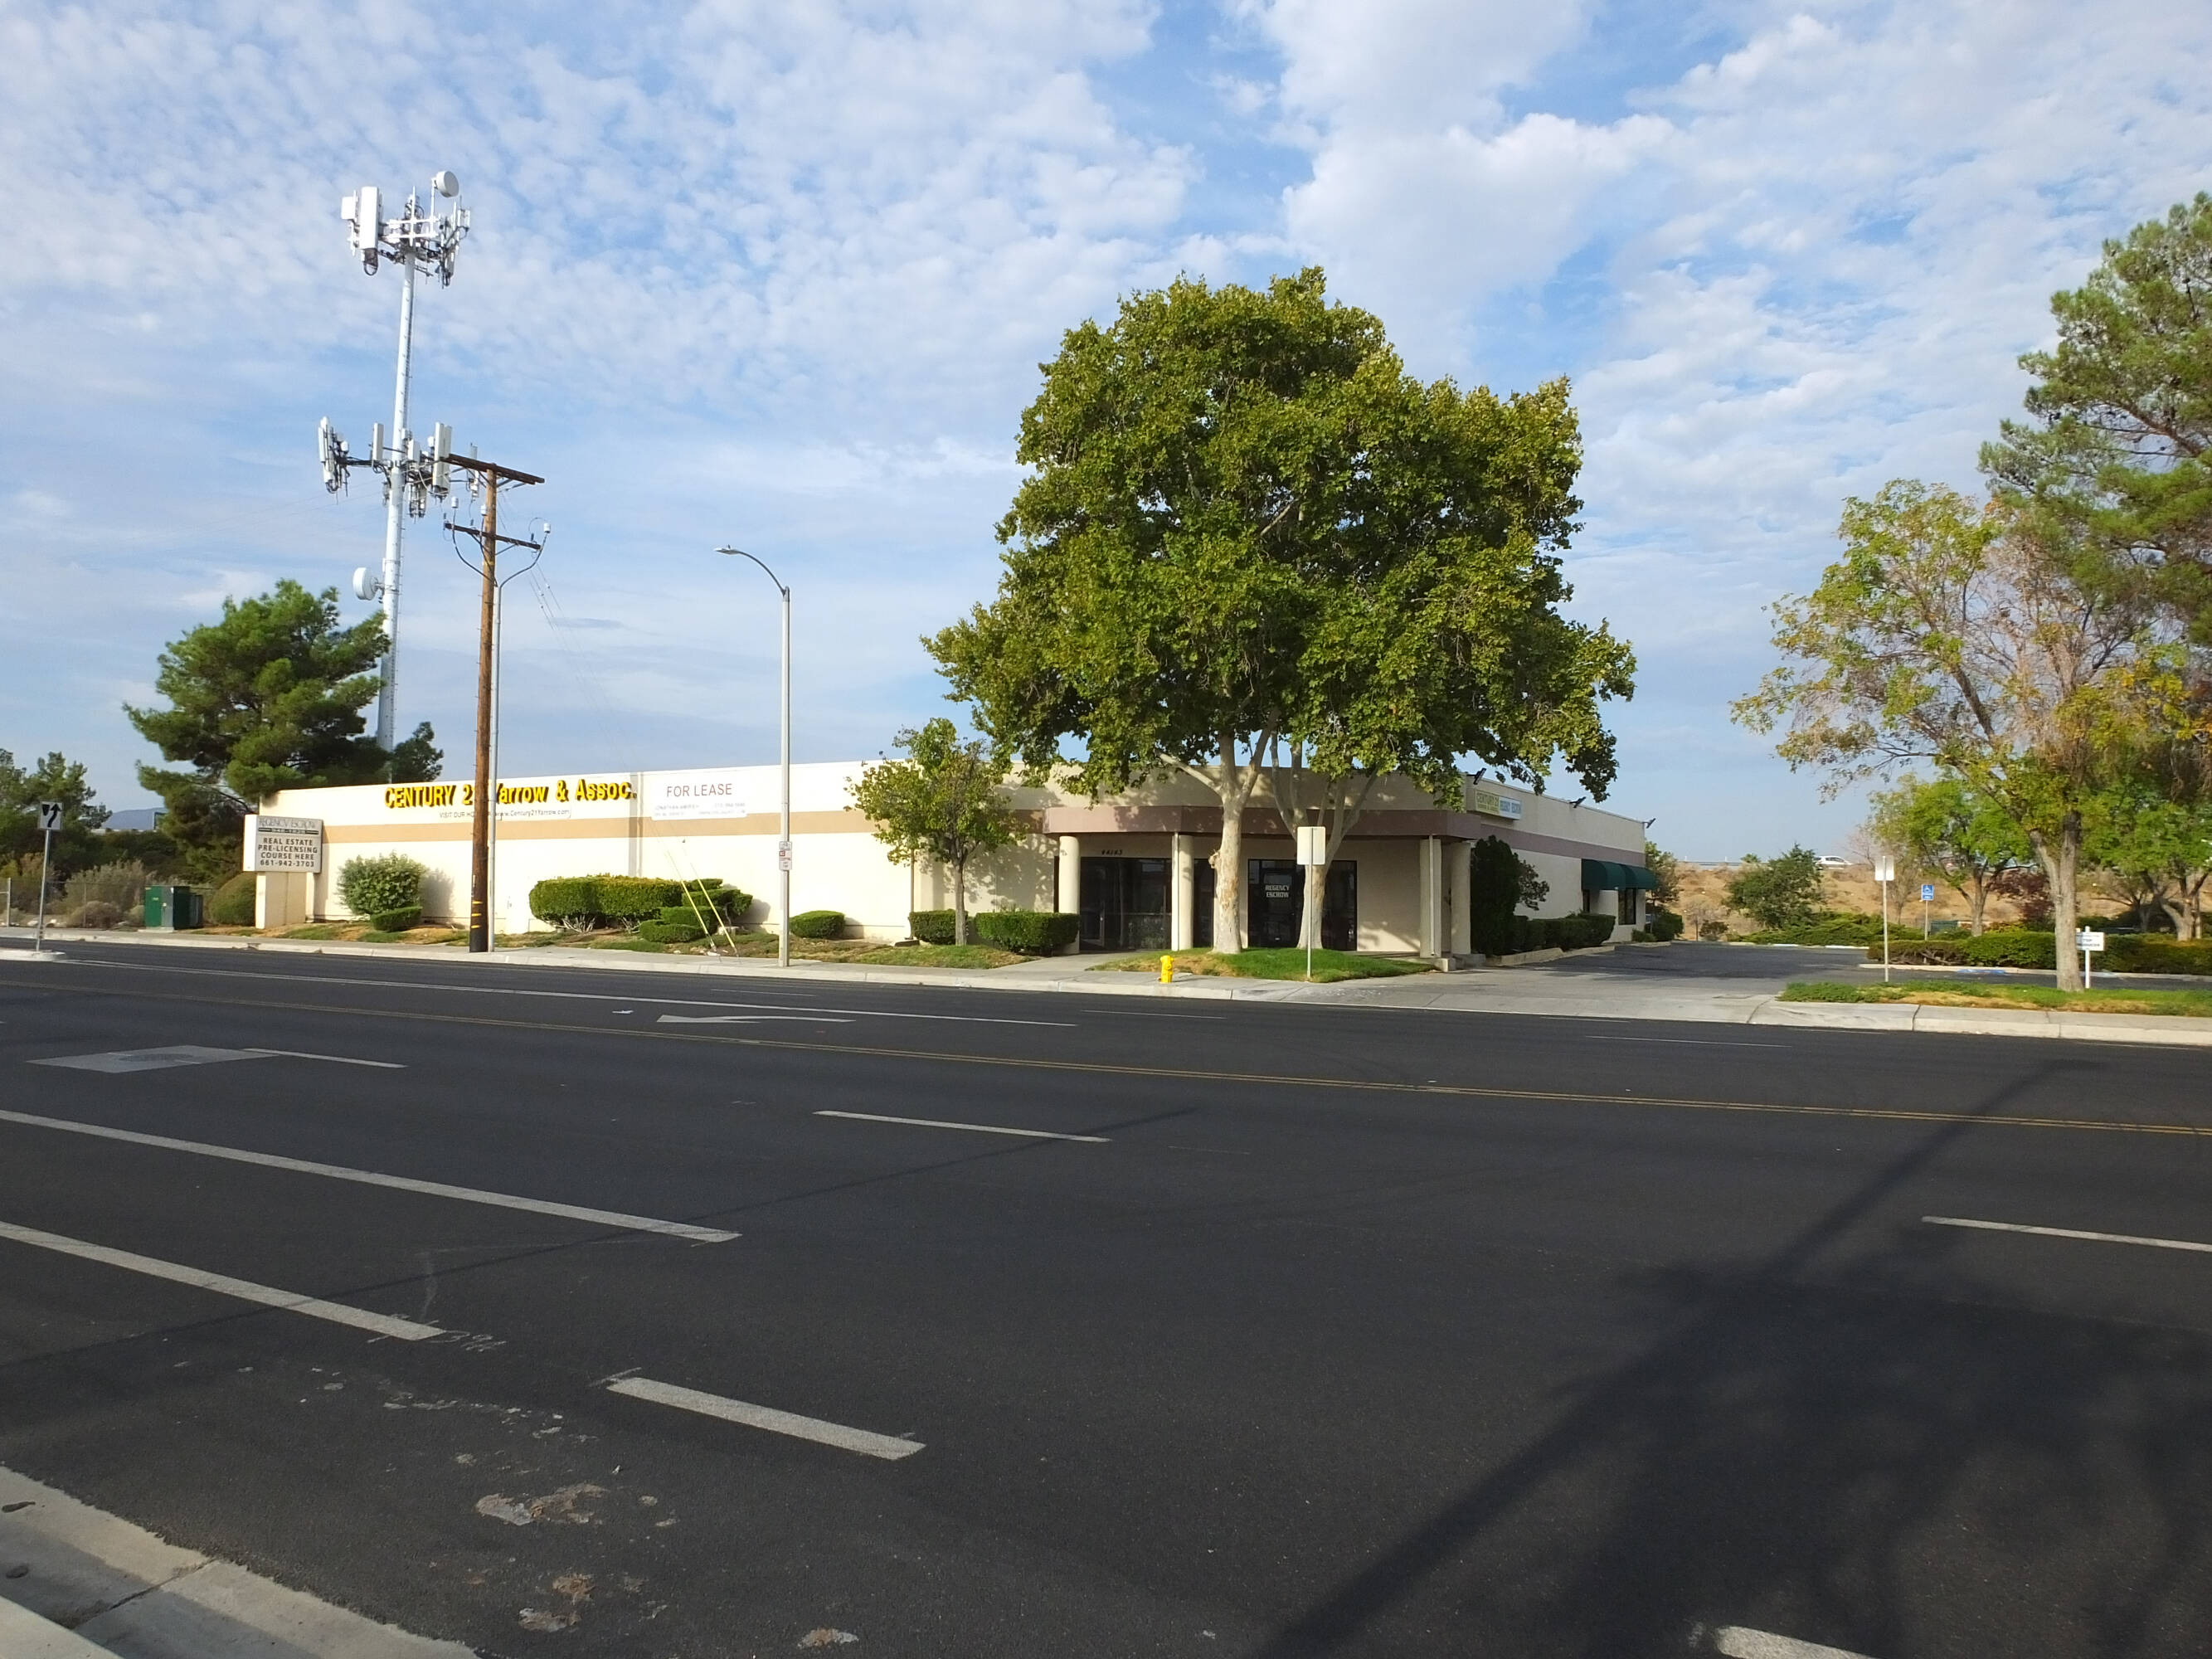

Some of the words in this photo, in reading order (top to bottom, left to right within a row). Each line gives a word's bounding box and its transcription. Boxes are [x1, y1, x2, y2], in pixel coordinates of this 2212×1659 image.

[385, 785, 455, 808] CENTURY
[556, 780, 569, 802] &
[575, 778, 637, 801] Assoc.
[666, 785, 690, 797] FOR
[694, 783, 732, 796] LEASE
[258, 844, 318, 853] PRE-LICENSING
